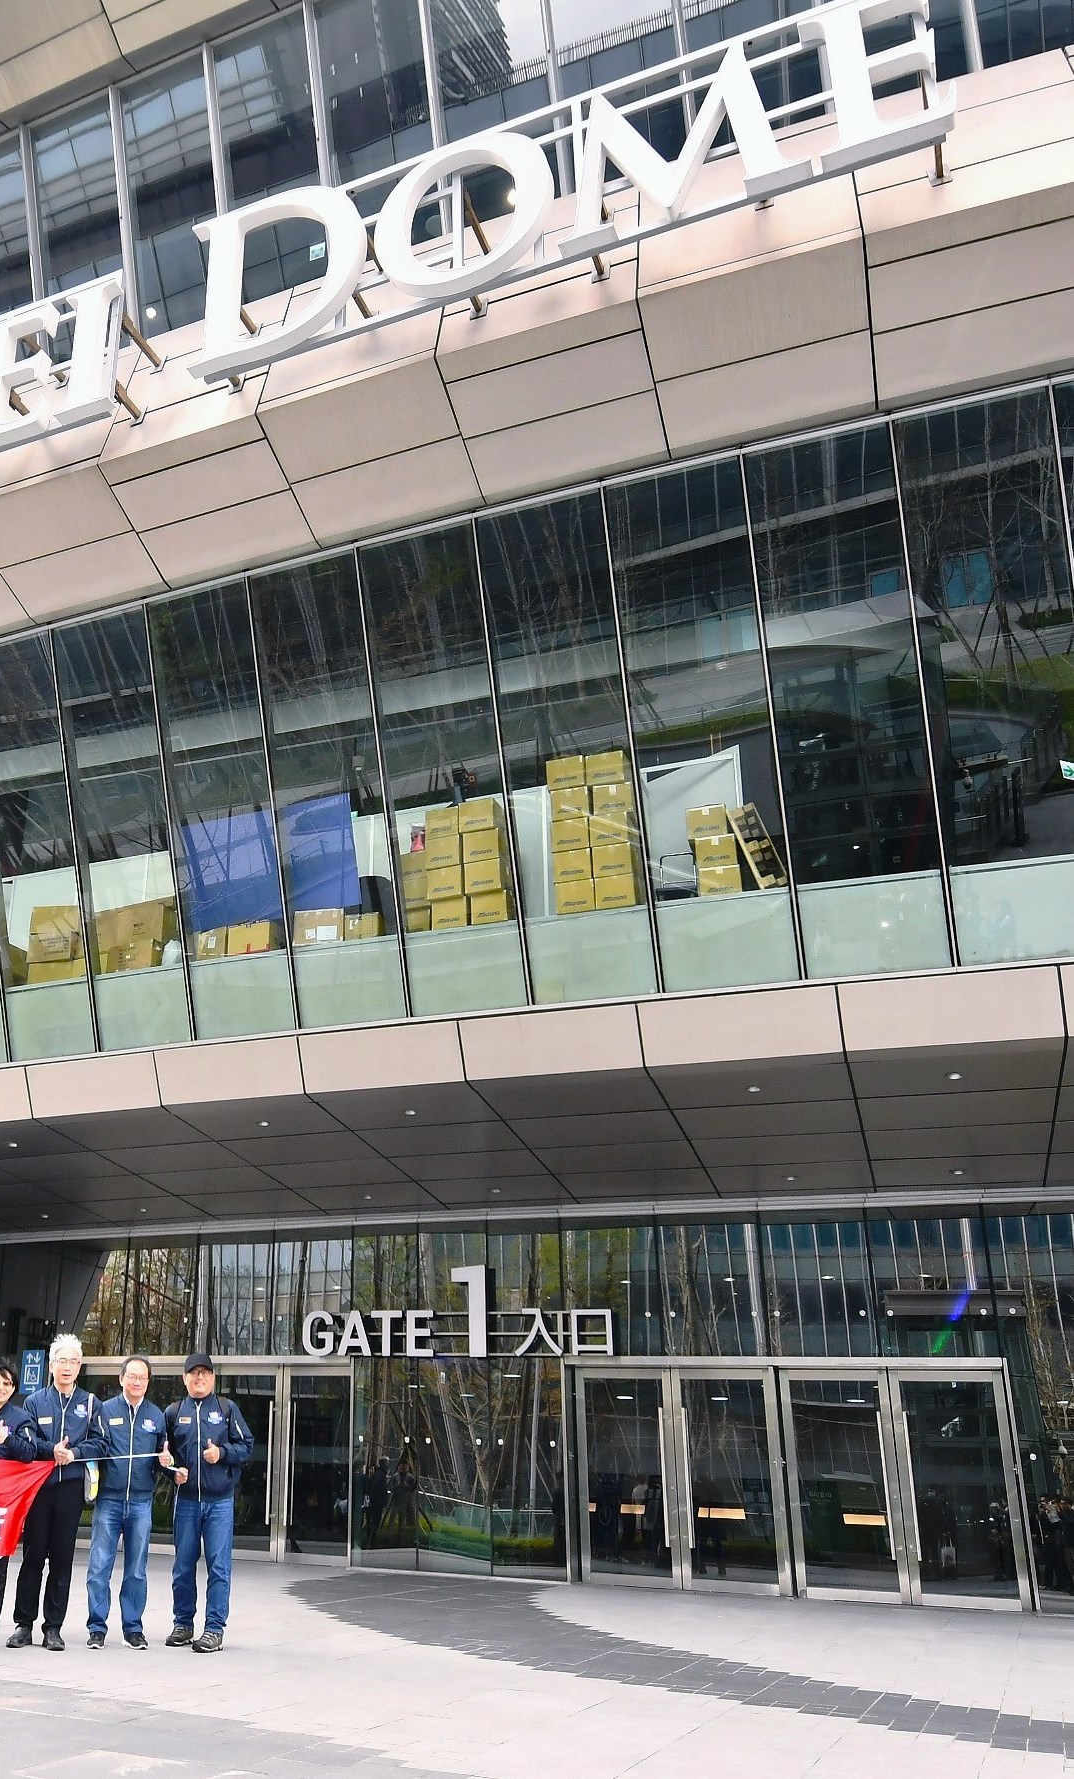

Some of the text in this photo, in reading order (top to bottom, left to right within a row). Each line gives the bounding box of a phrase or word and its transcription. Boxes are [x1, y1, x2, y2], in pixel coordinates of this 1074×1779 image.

[186, 0, 957, 384] DOME
[302, 1264, 614, 1358] GATE 1 入口
